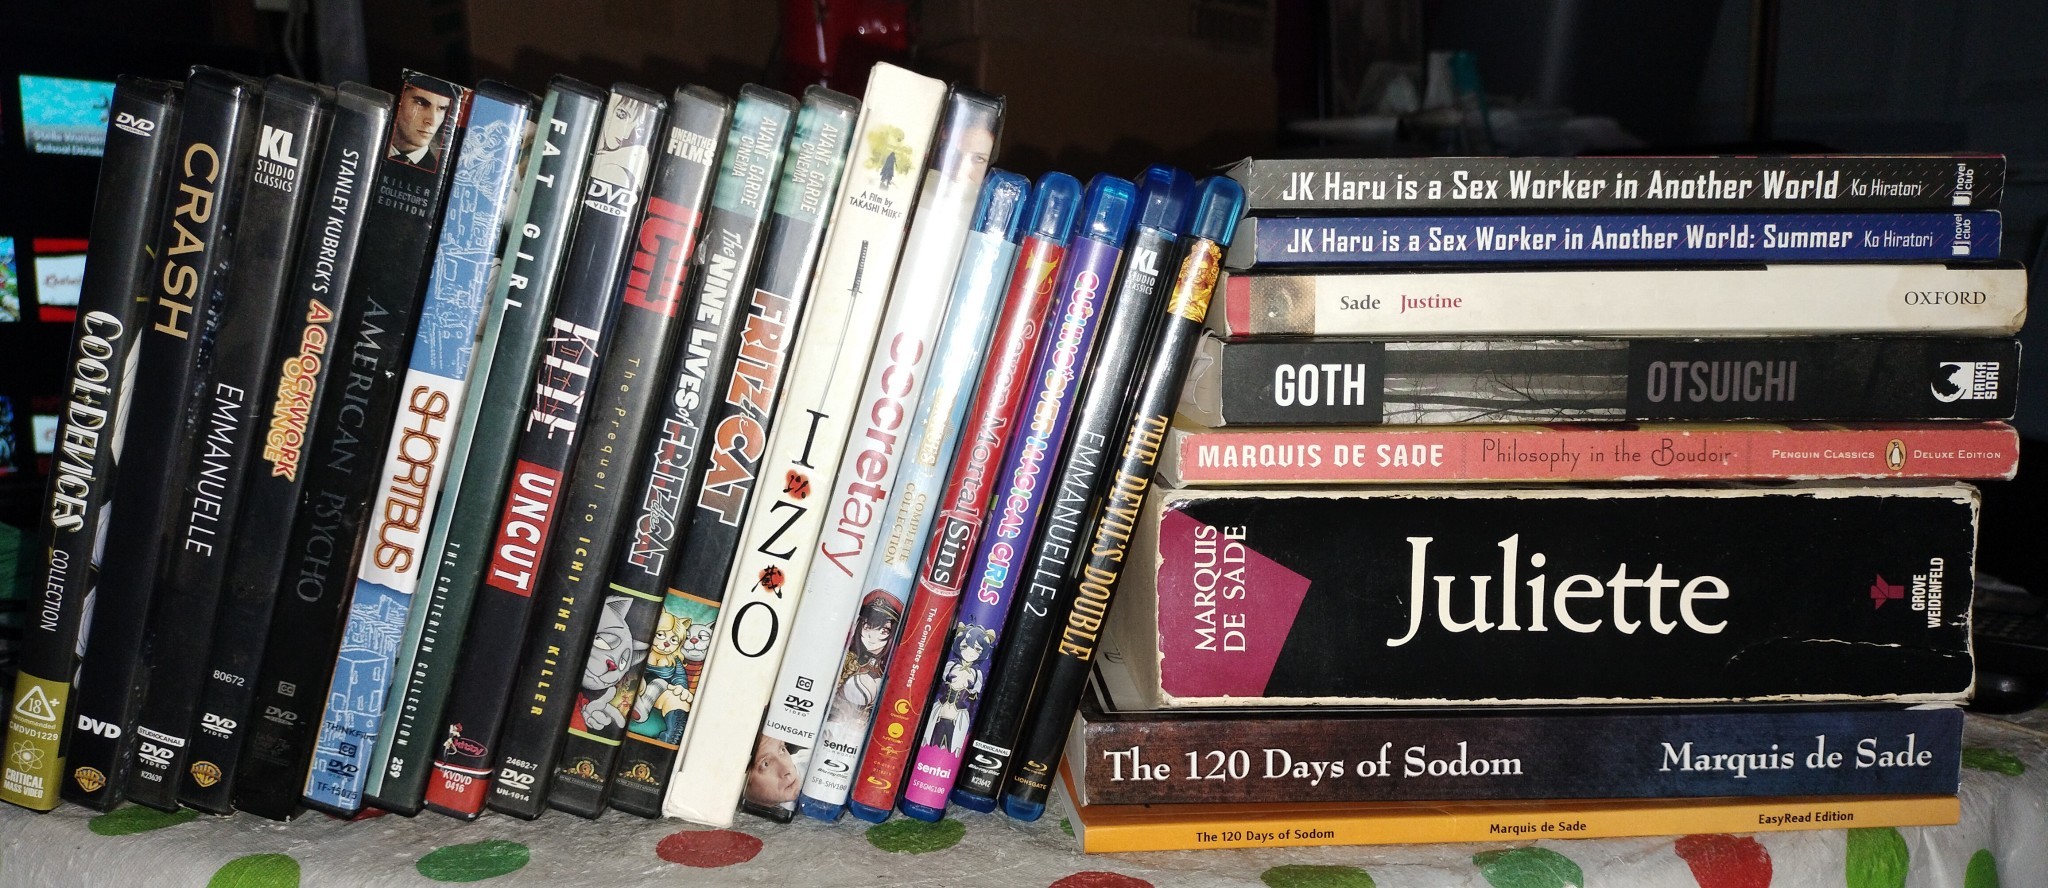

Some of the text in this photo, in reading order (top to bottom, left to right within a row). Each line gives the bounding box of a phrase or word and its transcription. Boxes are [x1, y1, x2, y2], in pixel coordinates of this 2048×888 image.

[258, 125, 298, 166] KL
[667, 138, 714, 166] FILMS
[732, 135, 754, 178] CINEMA
[257, 159, 295, 181] STUDIO
[791, 142, 815, 185] CINEMA
[1956, 163, 1968, 190] novel
[254, 172, 293, 193] CLASSICS
[382, 175, 430, 197] KILLER
[1282, 169, 1922, 202] JK Haru is a Sex Worker in Another World Ko Hiratori
[1964, 168, 1975, 190] club
[377, 195, 426, 218] EDITION
[380, 185, 428, 207] COLLECTOR'S
[850, 197, 902, 218] TAKASHI MIIKE
[860, 190, 893, 208] A Film by
[312, 149, 359, 294] STANLEY KUBRICK'S
[505, 118, 568, 311] FAT GIRL
[1953, 213, 1963, 241] novel
[154, 143, 220, 341] CRASH
[1287, 224, 1934, 253] JK Haru is a Sex Worker in Another World: Summer Ko Hiratori
[1963, 218, 1972, 240] club
[624, 196, 703, 318] ICHI
[1130, 247, 1159, 277] KL
[1125, 279, 1154, 295] CLASSICS
[1128, 271, 1156, 287] STUDIO
[1340, 294, 1463, 315] Sade Justine
[1904, 290, 1987, 306] OXFORD
[675, 228, 744, 410] The NINE LIVES
[272, 298, 334, 483] A CLOCKWORK
[1273, 363, 1367, 408] GOTH
[1646, 360, 1799, 404] OTSUICHI
[1973, 361, 1988, 400] HAIKA
[1985, 361, 2000, 400] SORU
[51, 311, 123, 533] COOL DEVICES
[264, 357, 303, 464] ORANGE
[697, 288, 793, 528] FRITZ CAT
[296, 296, 391, 603] AMERICAN PSYCHO
[1197, 443, 1445, 469] MARQUIS DE SADE
[1482, 437, 1733, 473] Philosophy in the Boudoir
[1771, 448, 1876, 460] PENGUIN CLASSICS
[1913, 449, 2002, 460] DELUXE EDITION
[185, 383, 244, 557] EMMANUELLE
[955, 411, 1007, 517] Mortal
[373, 385, 449, 574] SHORTBUS
[628, 407, 699, 576] of FRITZ CAT
[494, 472, 556, 591] UNCUT
[884, 482, 916, 566] COLLECTION
[900, 493, 926, 563] COMPLETE
[977, 436, 1048, 606] MAGICAL GIRLS
[1024, 433, 1105, 618] EMMANUELLE 2
[531, 358, 641, 716] The Prequel to ICHI THE KILLER
[1058, 412, 1169, 662] THE DEVIL'S DOUBLE
[933, 520, 972, 585] Sins
[41, 549, 70, 632] COLLECTION
[1194, 525, 1222, 652] MARQUIS
[1223, 525, 1248, 652] DE SADE
[1387, 533, 1730, 647] Juliette
[1911, 573, 1927, 612] GROVE
[1927, 556, 1944, 629] WEIDENFELD
[397, 542, 460, 747] THE CRITERION COLLECTION
[907, 607, 938, 688] The Complete Series
[212, 670, 245, 686] 80672
[9, 721, 59, 740] CMDVD1229
[78, 714, 121, 739] DVD
[203, 712, 237, 729] DVD
[203, 728, 229, 740] VIDEO
[767, 719, 813, 739] LIONSGATE
[138, 727, 183, 746] STUDIOCANAL
[140, 742, 174, 759] DVD
[823, 739, 858, 755] sentai
[140, 758, 168, 770] VIDEO
[388, 756, 404, 779] 259
[506, 756, 539, 771] 24682-7
[1104, 741, 1524, 787] The 120 Days of Sodom
[1659, 733, 1933, 779] Marquis de Sade
[5, 767, 44, 789] CRITICAL
[442, 769, 472, 785] KVDVD
[501, 768, 535, 784] DVD
[917, 762, 951, 779] sentai
[971, 775, 992, 788] K23642
[1014, 775, 1047, 790] LIONSGATE
[3, 779, 44, 799] MASS VIDEO
[317, 781, 358, 799] TF-15075
[445, 780, 465, 793] 0416
[1489, 819, 1587, 837] Marquis de Sade
[1758, 810, 1855, 828] EasyRead Edition
[1196, 827, 1336, 846] The 120 Days of Sodom
